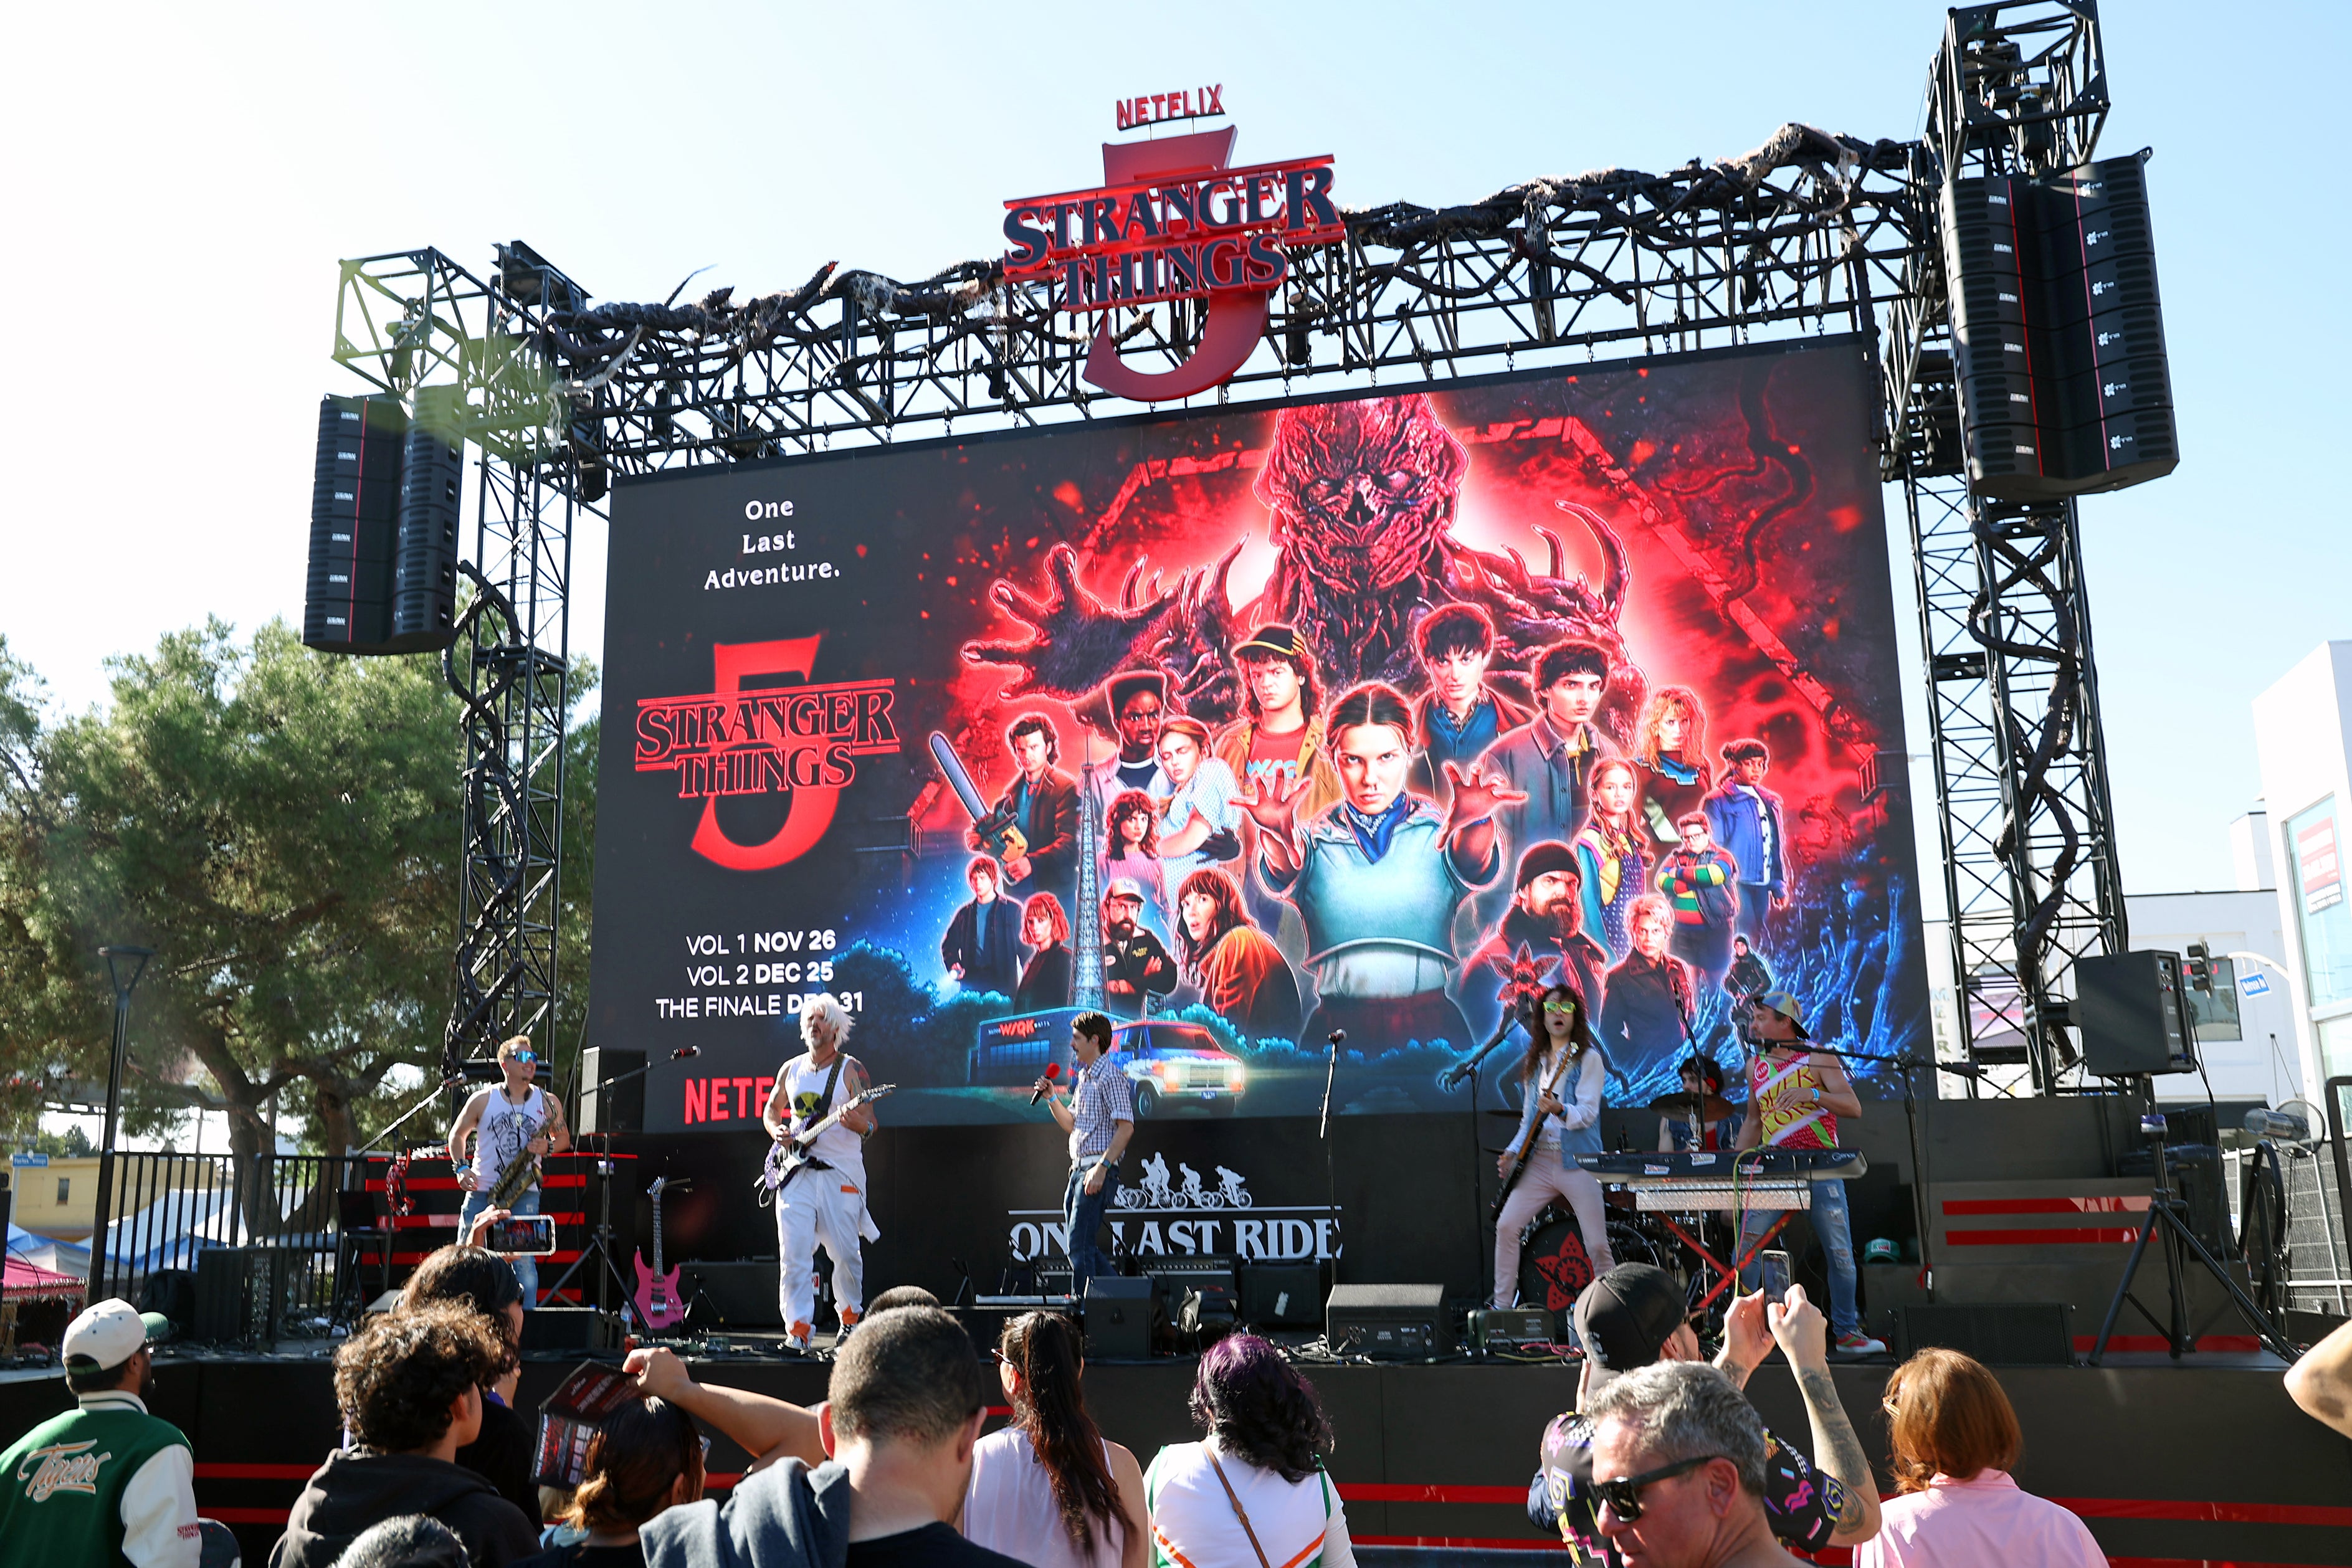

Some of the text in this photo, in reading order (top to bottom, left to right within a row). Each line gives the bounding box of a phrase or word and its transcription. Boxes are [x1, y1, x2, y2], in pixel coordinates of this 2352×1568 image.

[1116, 83, 1226, 131] NETFLIX
[1003, 166, 1343, 272] STRANGER
[1053, 232, 1288, 311] THINGS
[745, 500, 794, 521] One
[742, 530, 796, 554] Last
[704, 560, 840, 591] Adventure.
[636, 688, 900, 762] STRANGER
[674, 742, 856, 798] THINGS
[685, 928, 837, 956] VOL 1 NOV 26
[687, 961, 834, 987] VOL 2 DEC 25
[655, 998, 698, 1019] THE
[705, 994, 781, 1017] FINALE
[839, 991, 863, 1013] 31
[684, 1076, 791, 1125] NETF
[1009, 1217, 1343, 1263] ON LAST RIDE
[17, 1438, 112, 1503] Tigers
